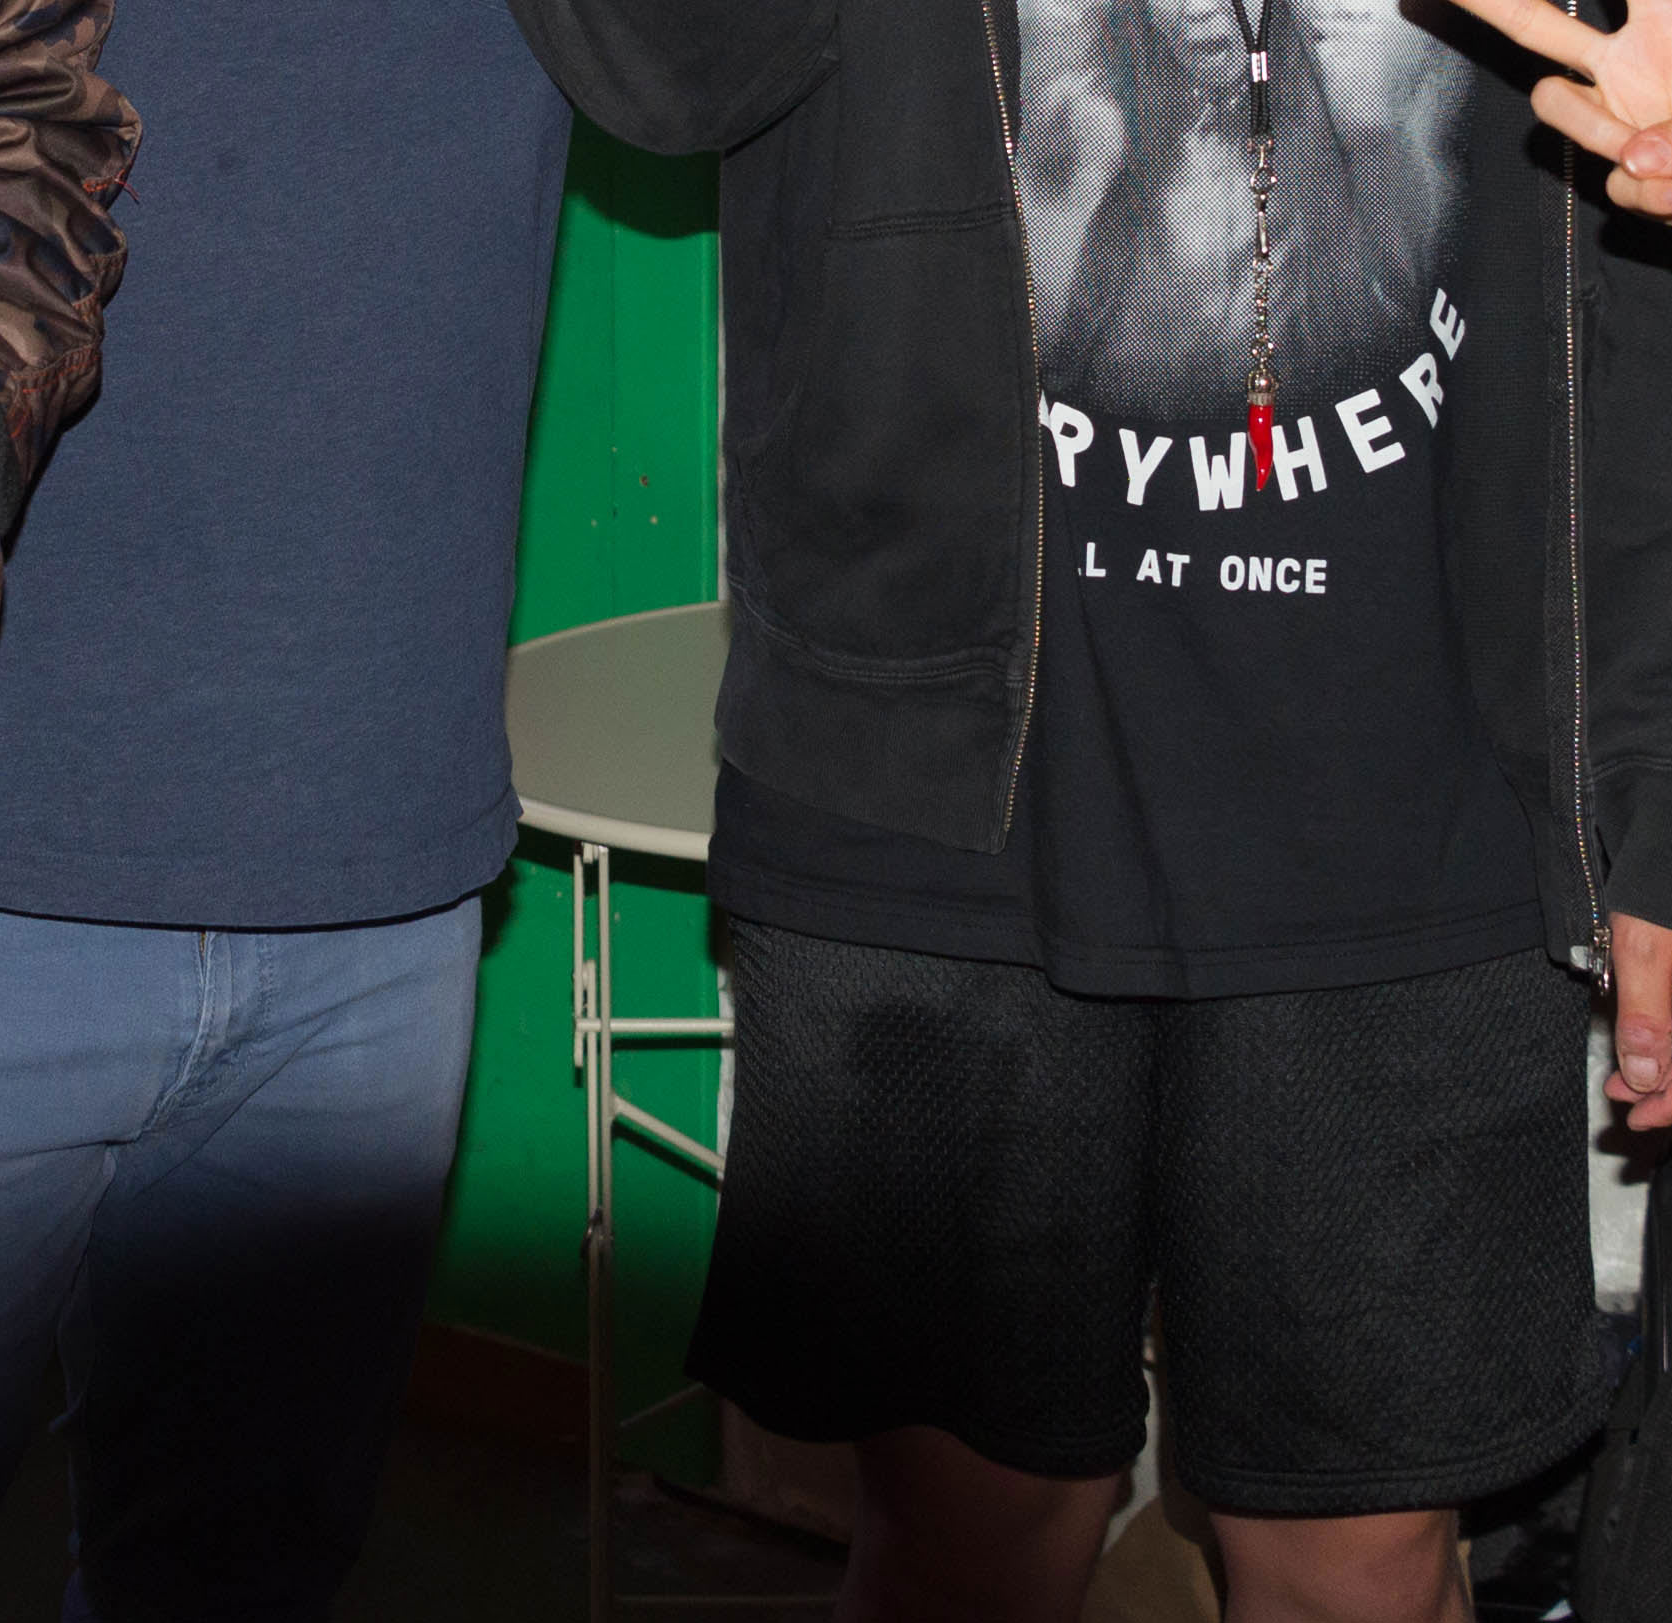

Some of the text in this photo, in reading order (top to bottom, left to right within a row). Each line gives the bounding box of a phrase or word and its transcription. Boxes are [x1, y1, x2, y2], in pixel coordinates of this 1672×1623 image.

[1078, 542, 1328, 594] L AT ONCE
